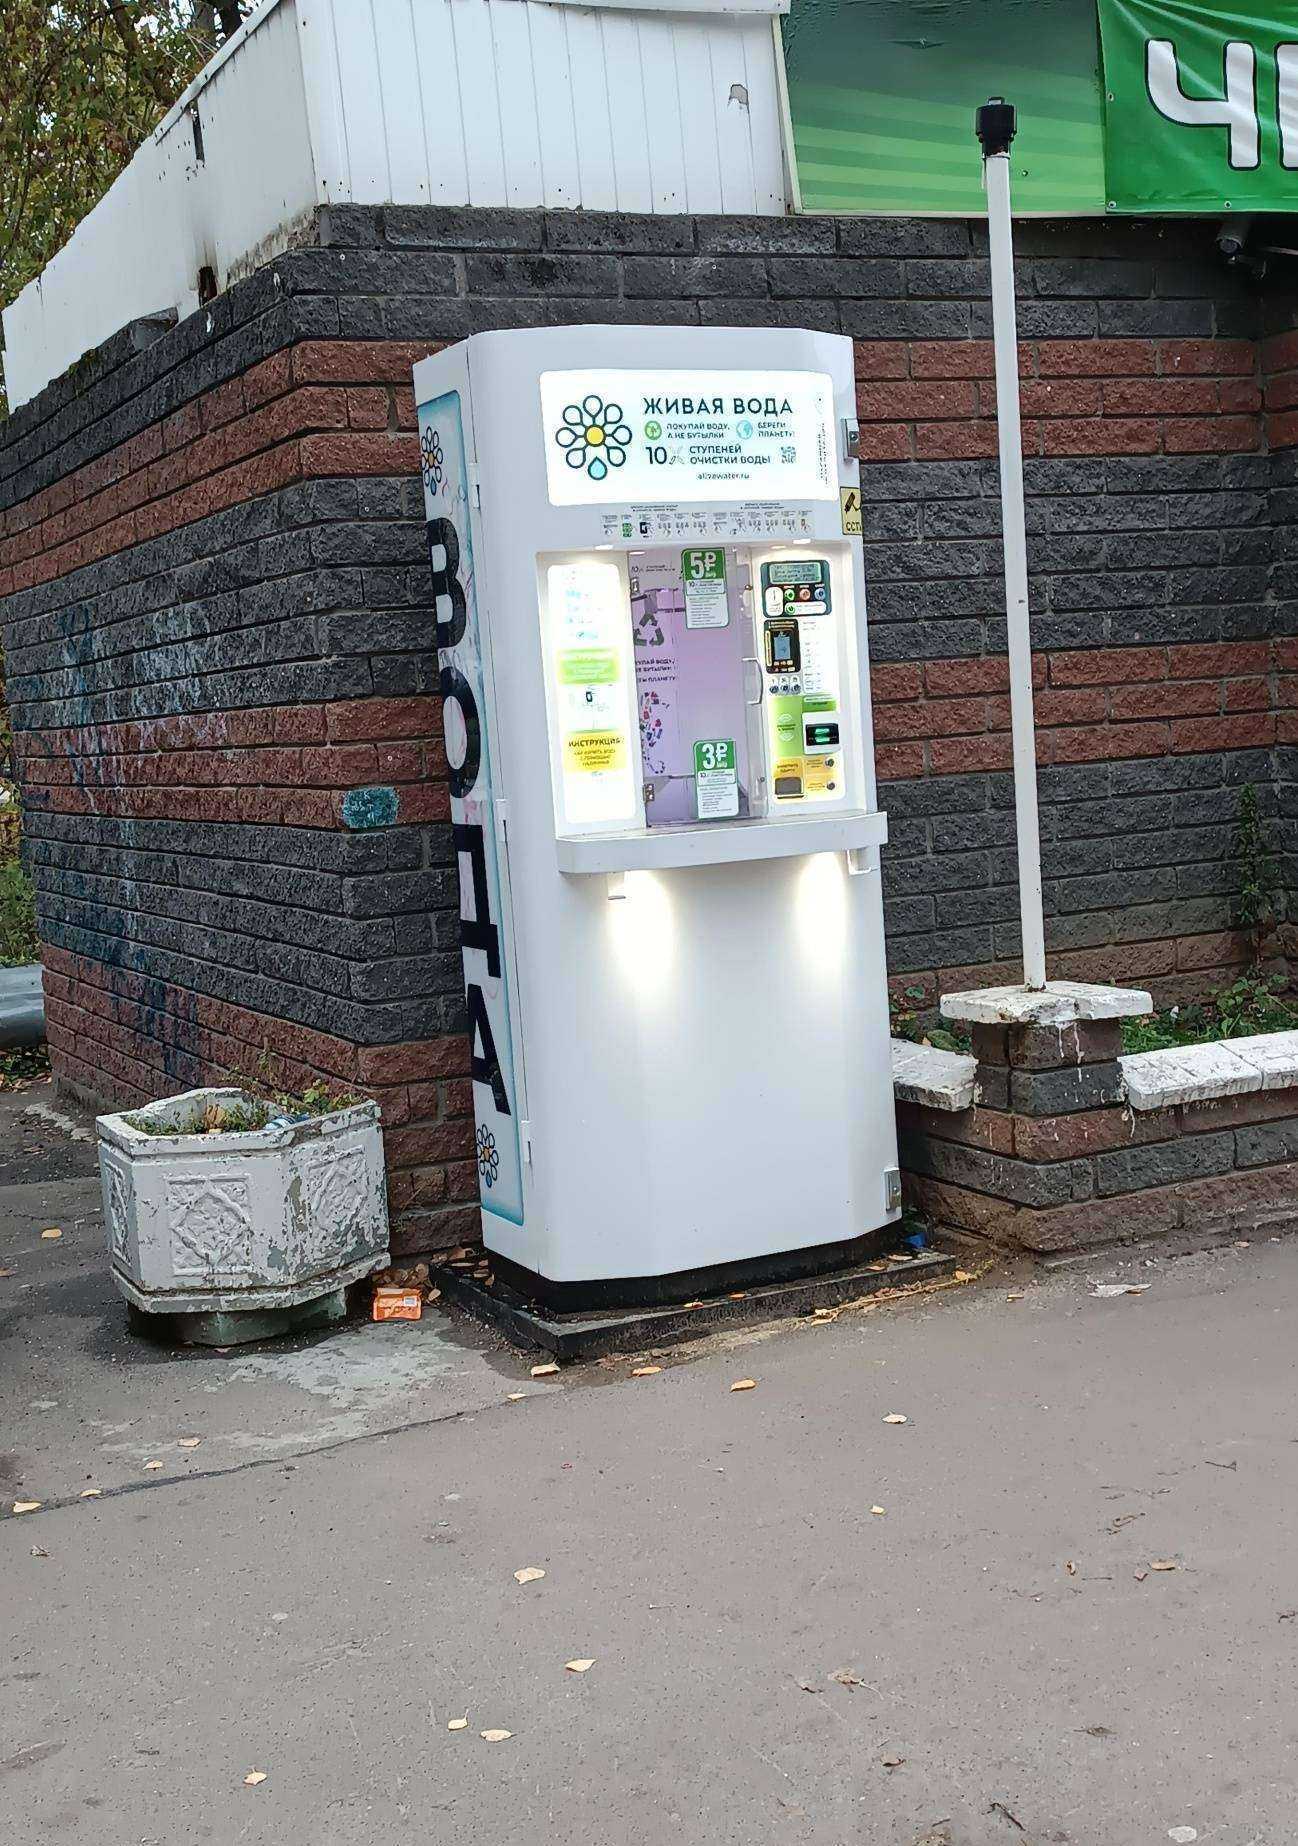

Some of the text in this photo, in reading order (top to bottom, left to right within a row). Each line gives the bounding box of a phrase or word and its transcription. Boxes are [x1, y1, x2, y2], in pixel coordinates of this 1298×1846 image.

[643, 398, 793, 417] ЖИВАЯ ВОДА
[666, 422, 730, 431] ПОКУПАЙ ВОДУ,
[758, 421, 786, 429] БЕРЕГИ
[687, 431, 724, 439] БУТЫЛКИ
[689, 443, 742, 454] СТУПЕНЕЙ
[646, 446, 668, 465] 10
[690, 455, 771, 465] ОЧИСТКИ ВОДЫ
